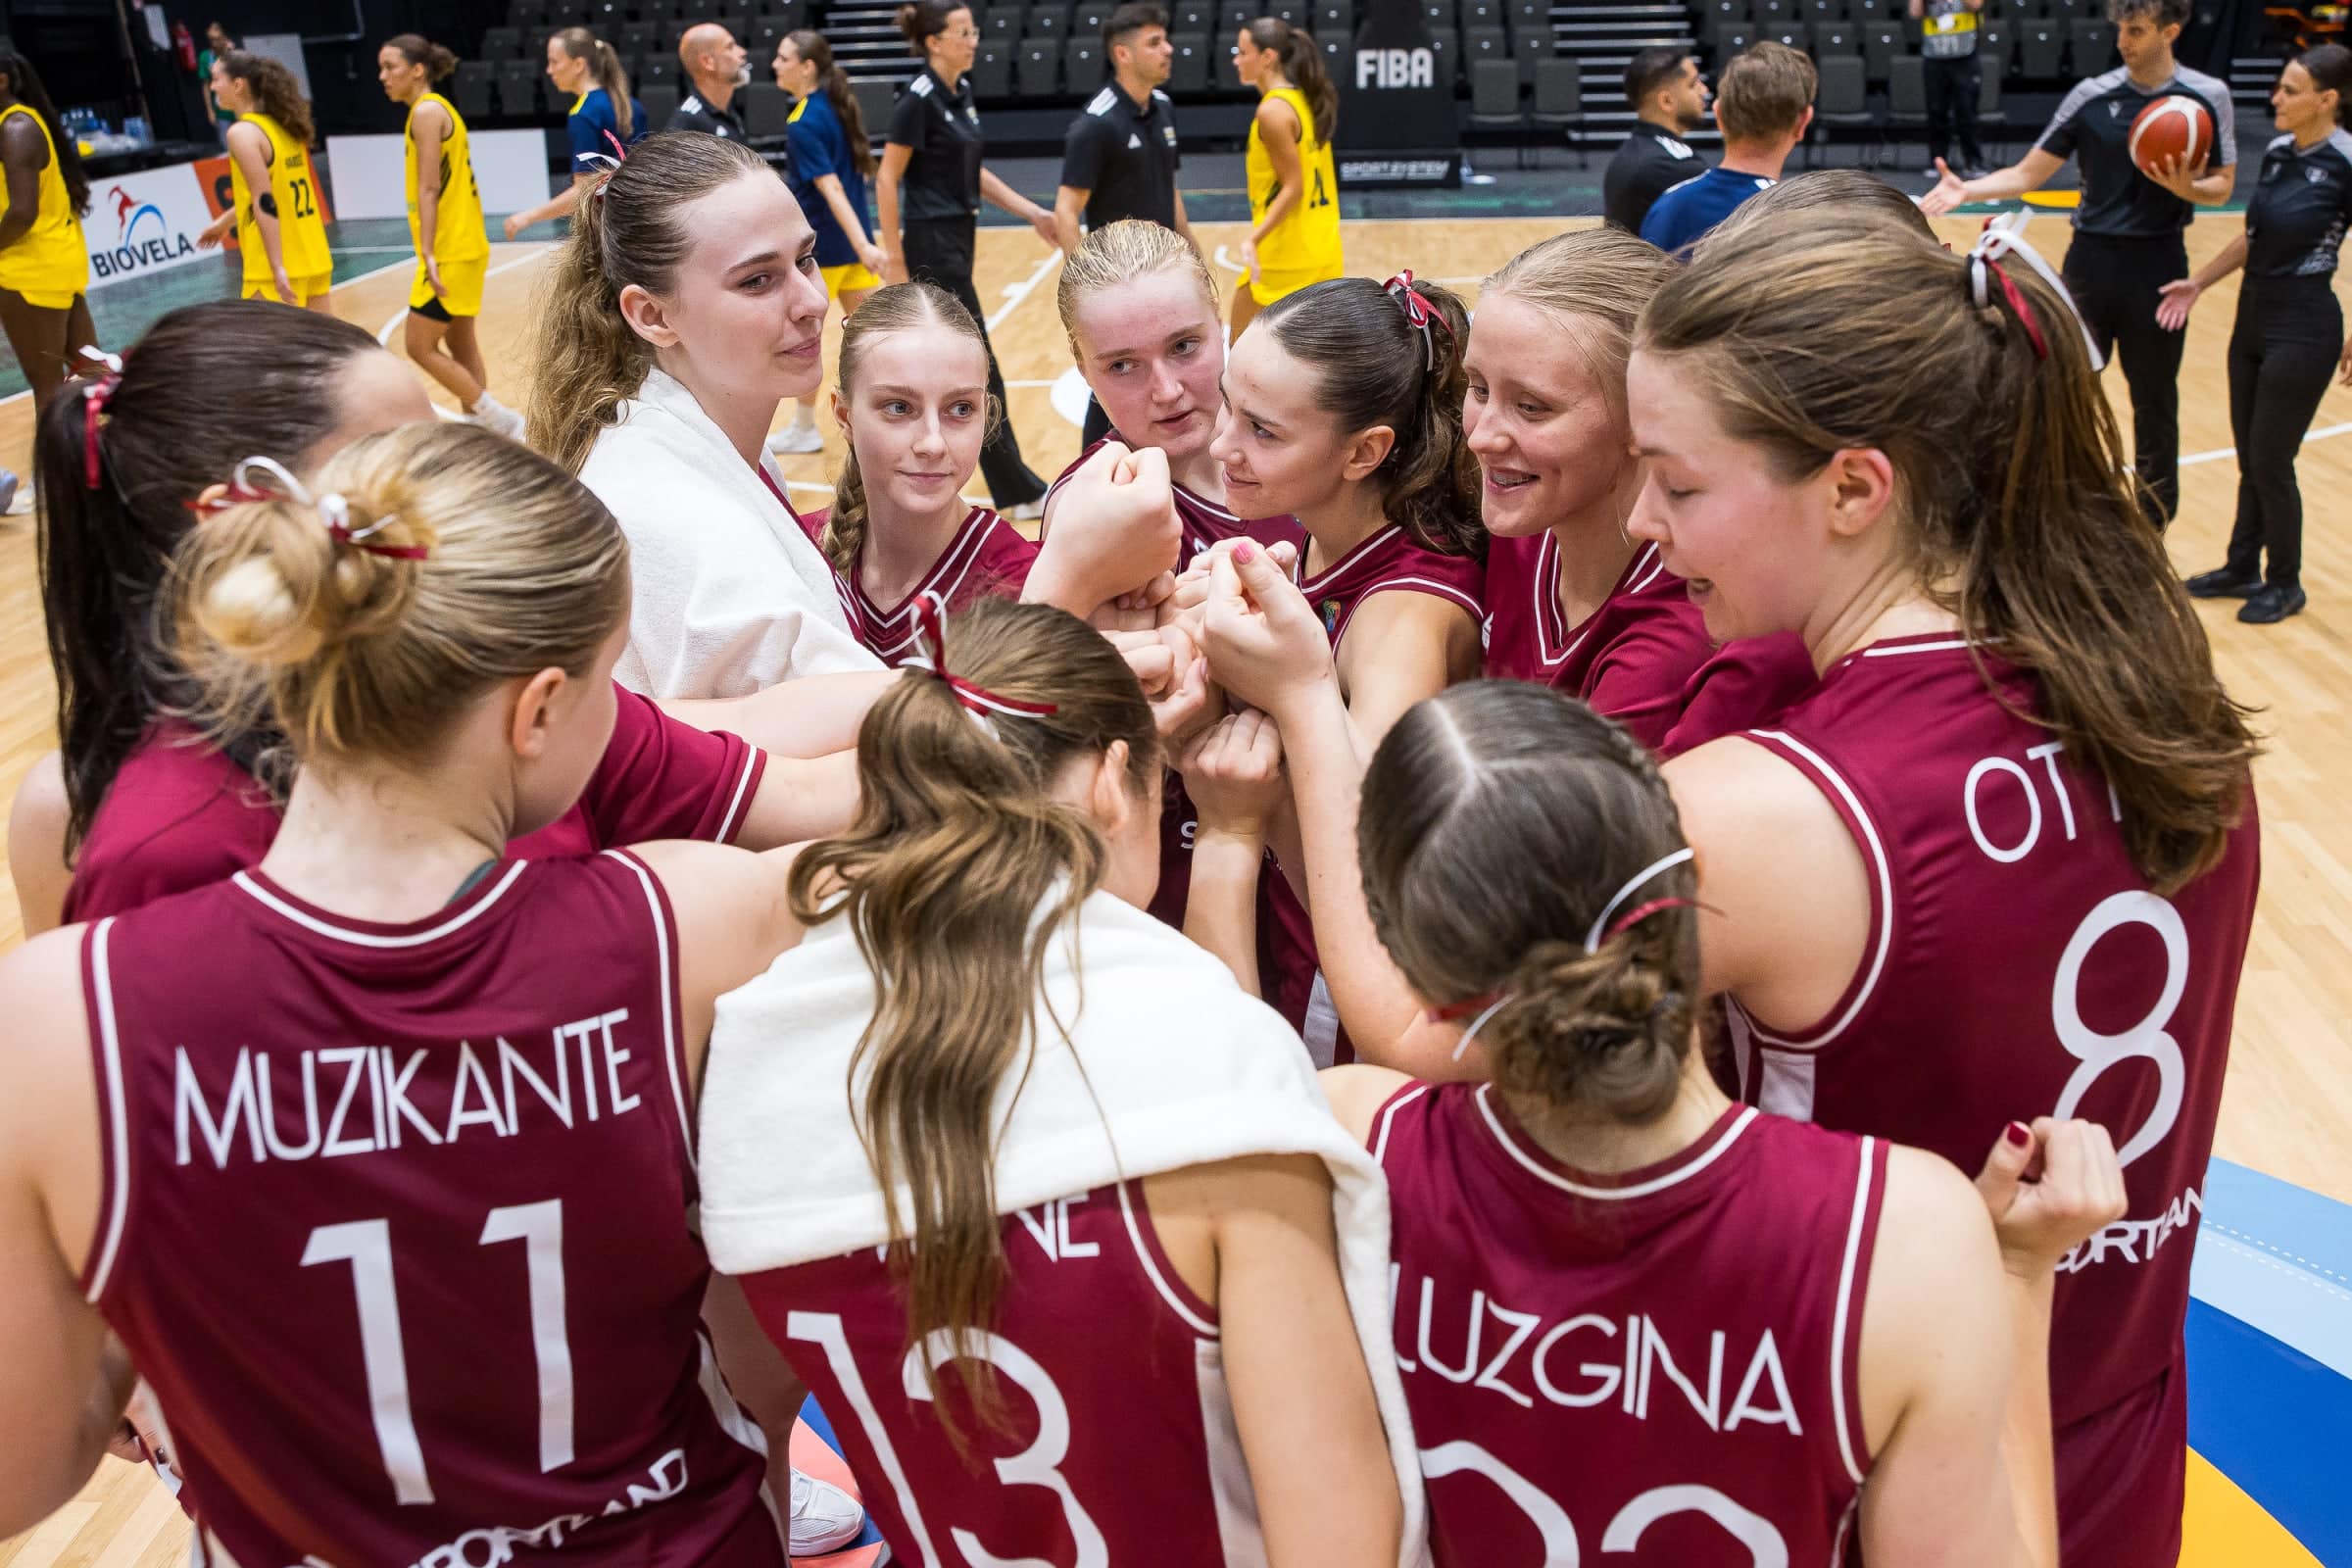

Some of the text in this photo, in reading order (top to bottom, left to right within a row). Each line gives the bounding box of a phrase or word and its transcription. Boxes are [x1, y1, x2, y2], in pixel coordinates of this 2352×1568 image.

[1355, 47, 1434, 89] FIBA
[91, 231, 196, 278] BIOVELA
[289, 178, 315, 220] 22
[174, 1007, 642, 1170] MUZIKANTE
[2052, 890, 2190, 1168] 8
[300, 1198, 575, 1506] 11
[1391, 1261, 1803, 1437] LUZGINA
[787, 1310, 1109, 1568] 13
